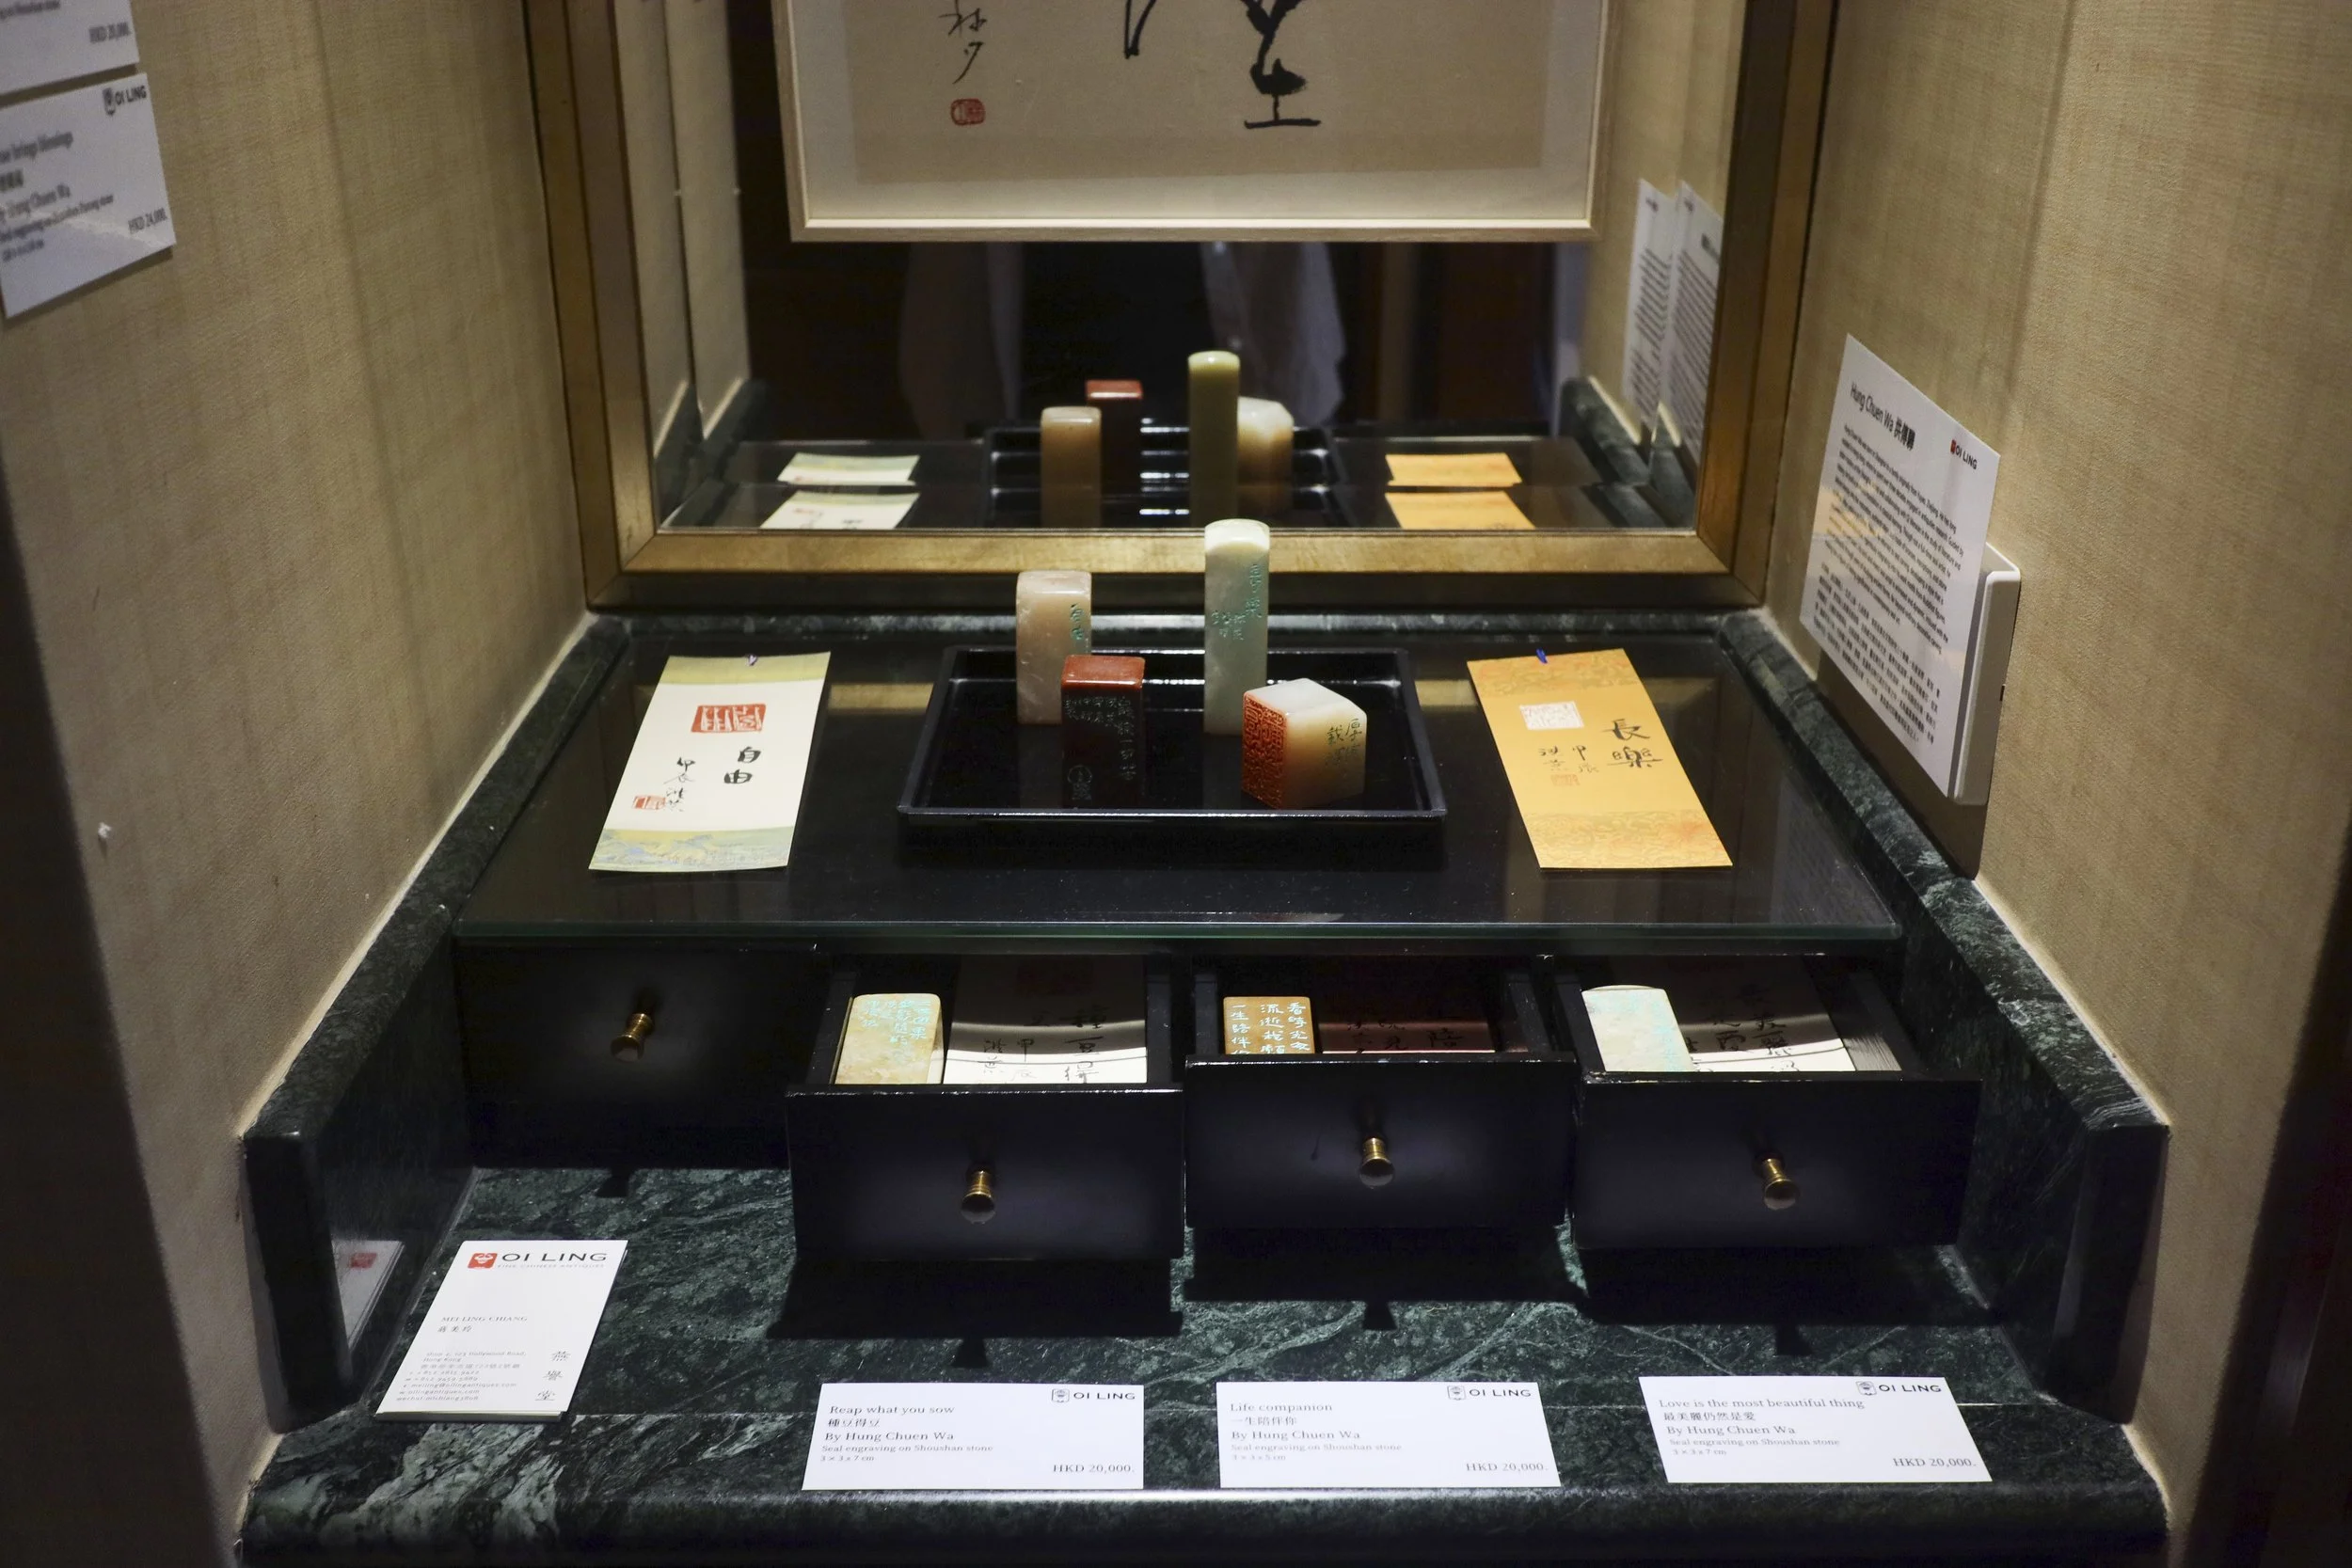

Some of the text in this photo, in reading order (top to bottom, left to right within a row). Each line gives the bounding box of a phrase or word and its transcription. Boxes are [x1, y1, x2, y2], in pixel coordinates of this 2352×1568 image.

[127, 86, 147, 103] LING
[1851, 383, 1866, 412] Hung
[1865, 395, 1883, 424] Chuen
[1883, 408, 1894, 433] Wa
[1963, 451, 1978, 469] LING
[1601, 718, 1663, 768] 長樂
[723, 746, 761, 784] 自由
[502, 1253, 608, 1261] OI LING
[1469, 1388, 1532, 1398] OI LING
[1878, 1384, 1943, 1393] OI LING
[1073, 1391, 1136, 1401] OI LING
[1231, 1403, 1333, 1414] Life companion
[1659, 1400, 1690, 1408] Love
[1694, 1400, 1705, 1408] is
[1708, 1399, 1728, 1408] the
[1768, 1399, 1826, 1407] beautiful
[1829, 1399, 1866, 1410] thing
[830, 1405, 863, 1416] Reap
[866, 1405, 898, 1414] what
[901, 1406, 925, 1416] you
[1232, 1430, 1360, 1441] By Hung Chuen Wa
[1667, 1425, 1796, 1436] By Hung Chuen Wa
[825, 1432, 954, 1443] By Hung Chuen Wa
[1692, 1438, 1744, 1448] engraving
[845, 1445, 897, 1453] engraving
[1466, 1463, 1498, 1472] HKD
[1893, 1457, 1926, 1467] HKD
[1053, 1464, 1085, 1474] HKD
